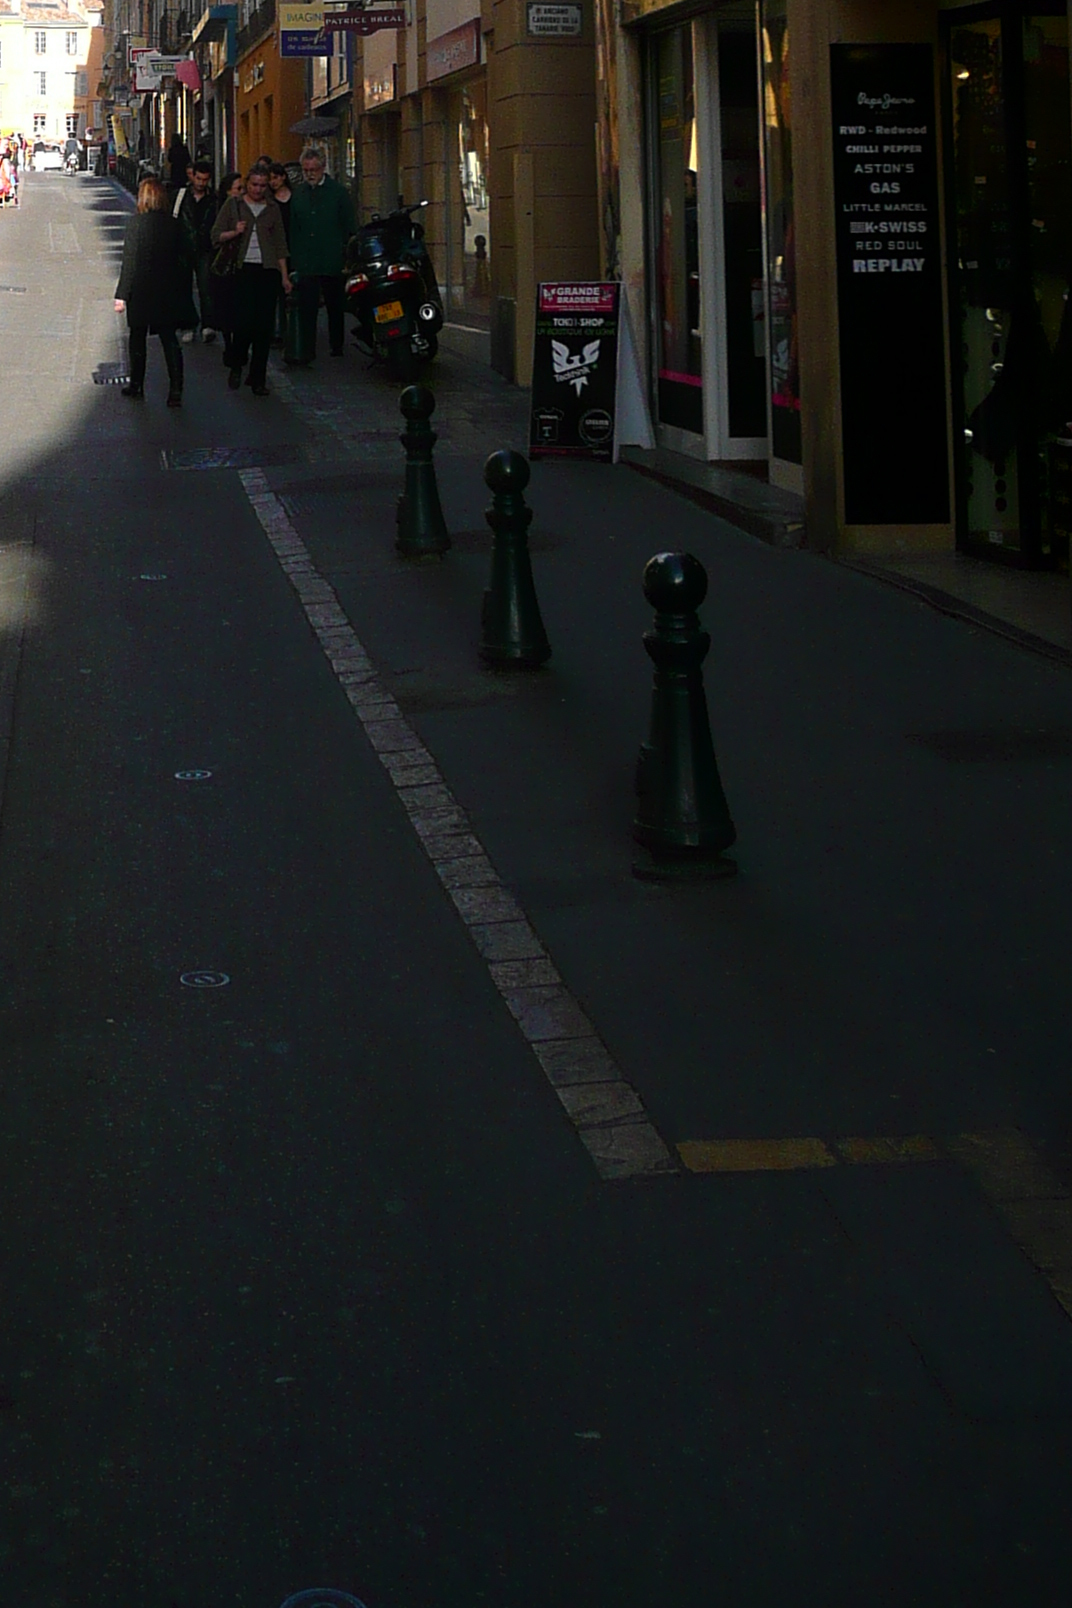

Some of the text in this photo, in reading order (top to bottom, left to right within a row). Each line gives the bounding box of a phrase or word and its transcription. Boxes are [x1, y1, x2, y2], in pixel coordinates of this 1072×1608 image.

[325, 17, 367, 25] PATRICE
[838, 125, 867, 135] RWD
[874, 125, 928, 135] Redwood
[845, 144, 923, 154] CHILLI PEPPER
[854, 163, 915, 174] ASTON'S
[869, 182, 901, 194] GAS
[843, 203, 928, 212] LITTLE MARCEL
[855, 241, 924, 251] RED SOUL
[852, 258, 926, 273] REPLAY
[556, 287, 601, 296] GRANDE
[556, 296, 600, 304] BRADERIE
